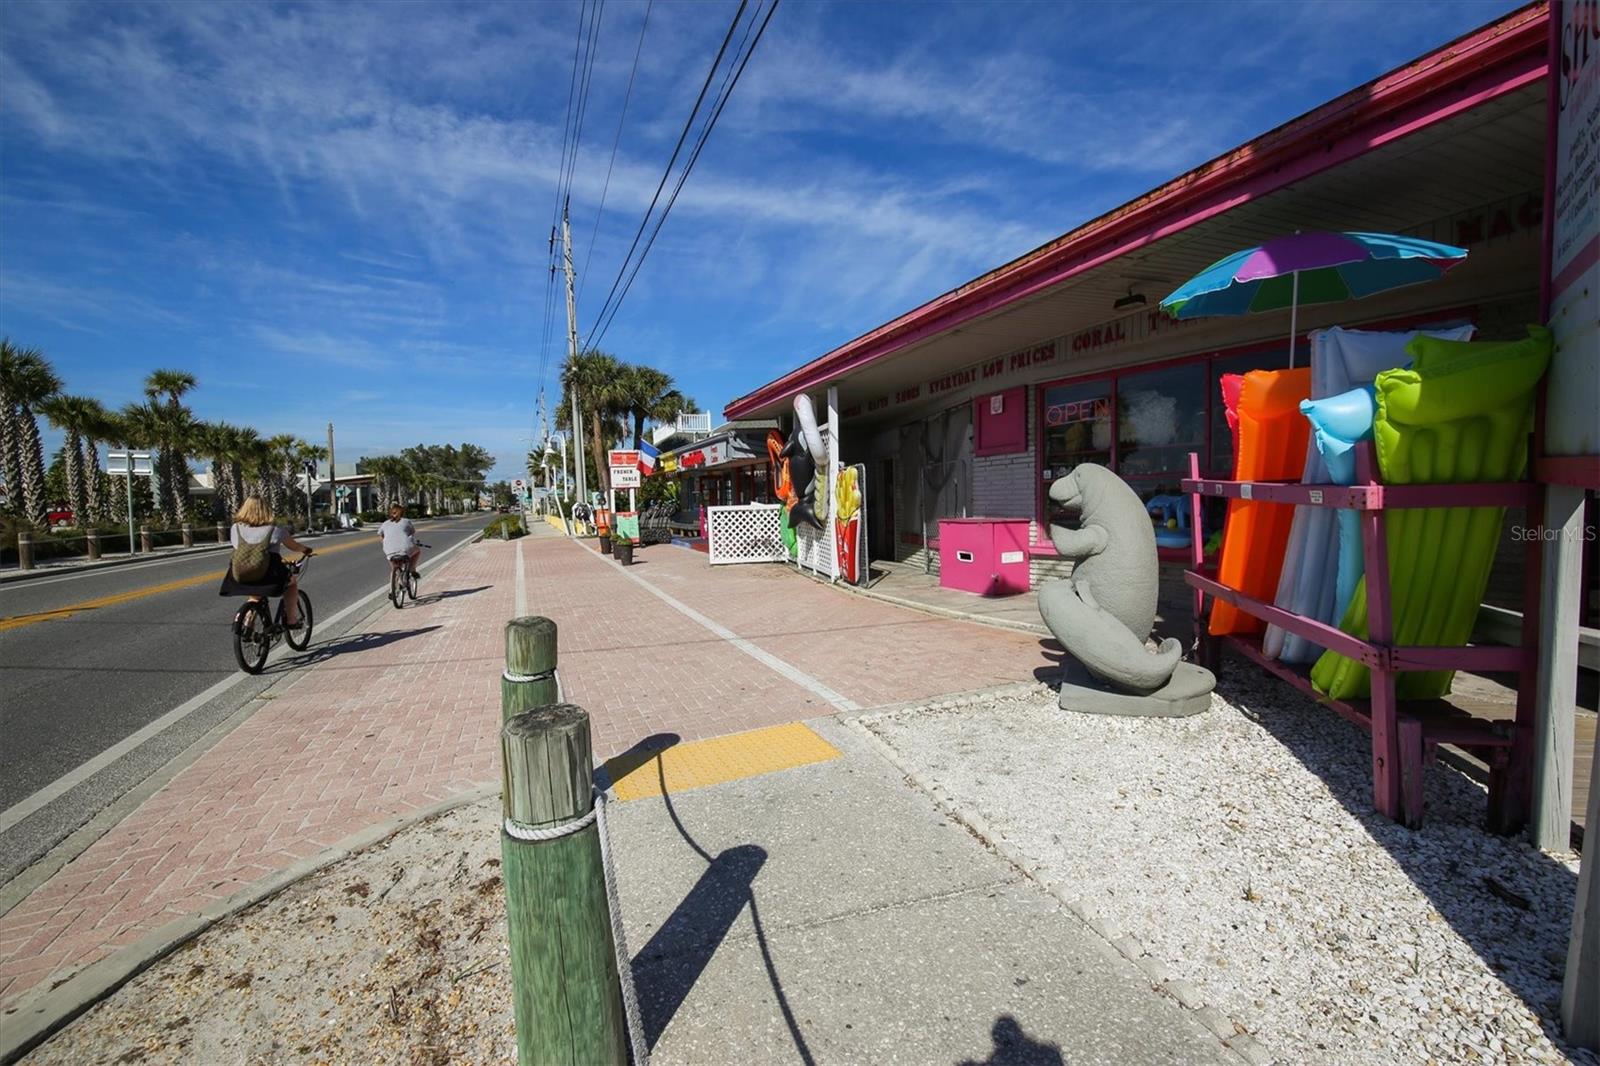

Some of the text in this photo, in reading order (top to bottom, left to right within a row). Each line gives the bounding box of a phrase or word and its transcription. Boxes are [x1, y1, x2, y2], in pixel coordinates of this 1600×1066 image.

[1072, 322, 1125, 352] CORAL
[929, 369, 976, 394] EVERYDAY
[983, 359, 1004, 378] LOW
[1010, 343, 1056, 371] PRICES
[1047, 398, 1111, 425] OPEN
